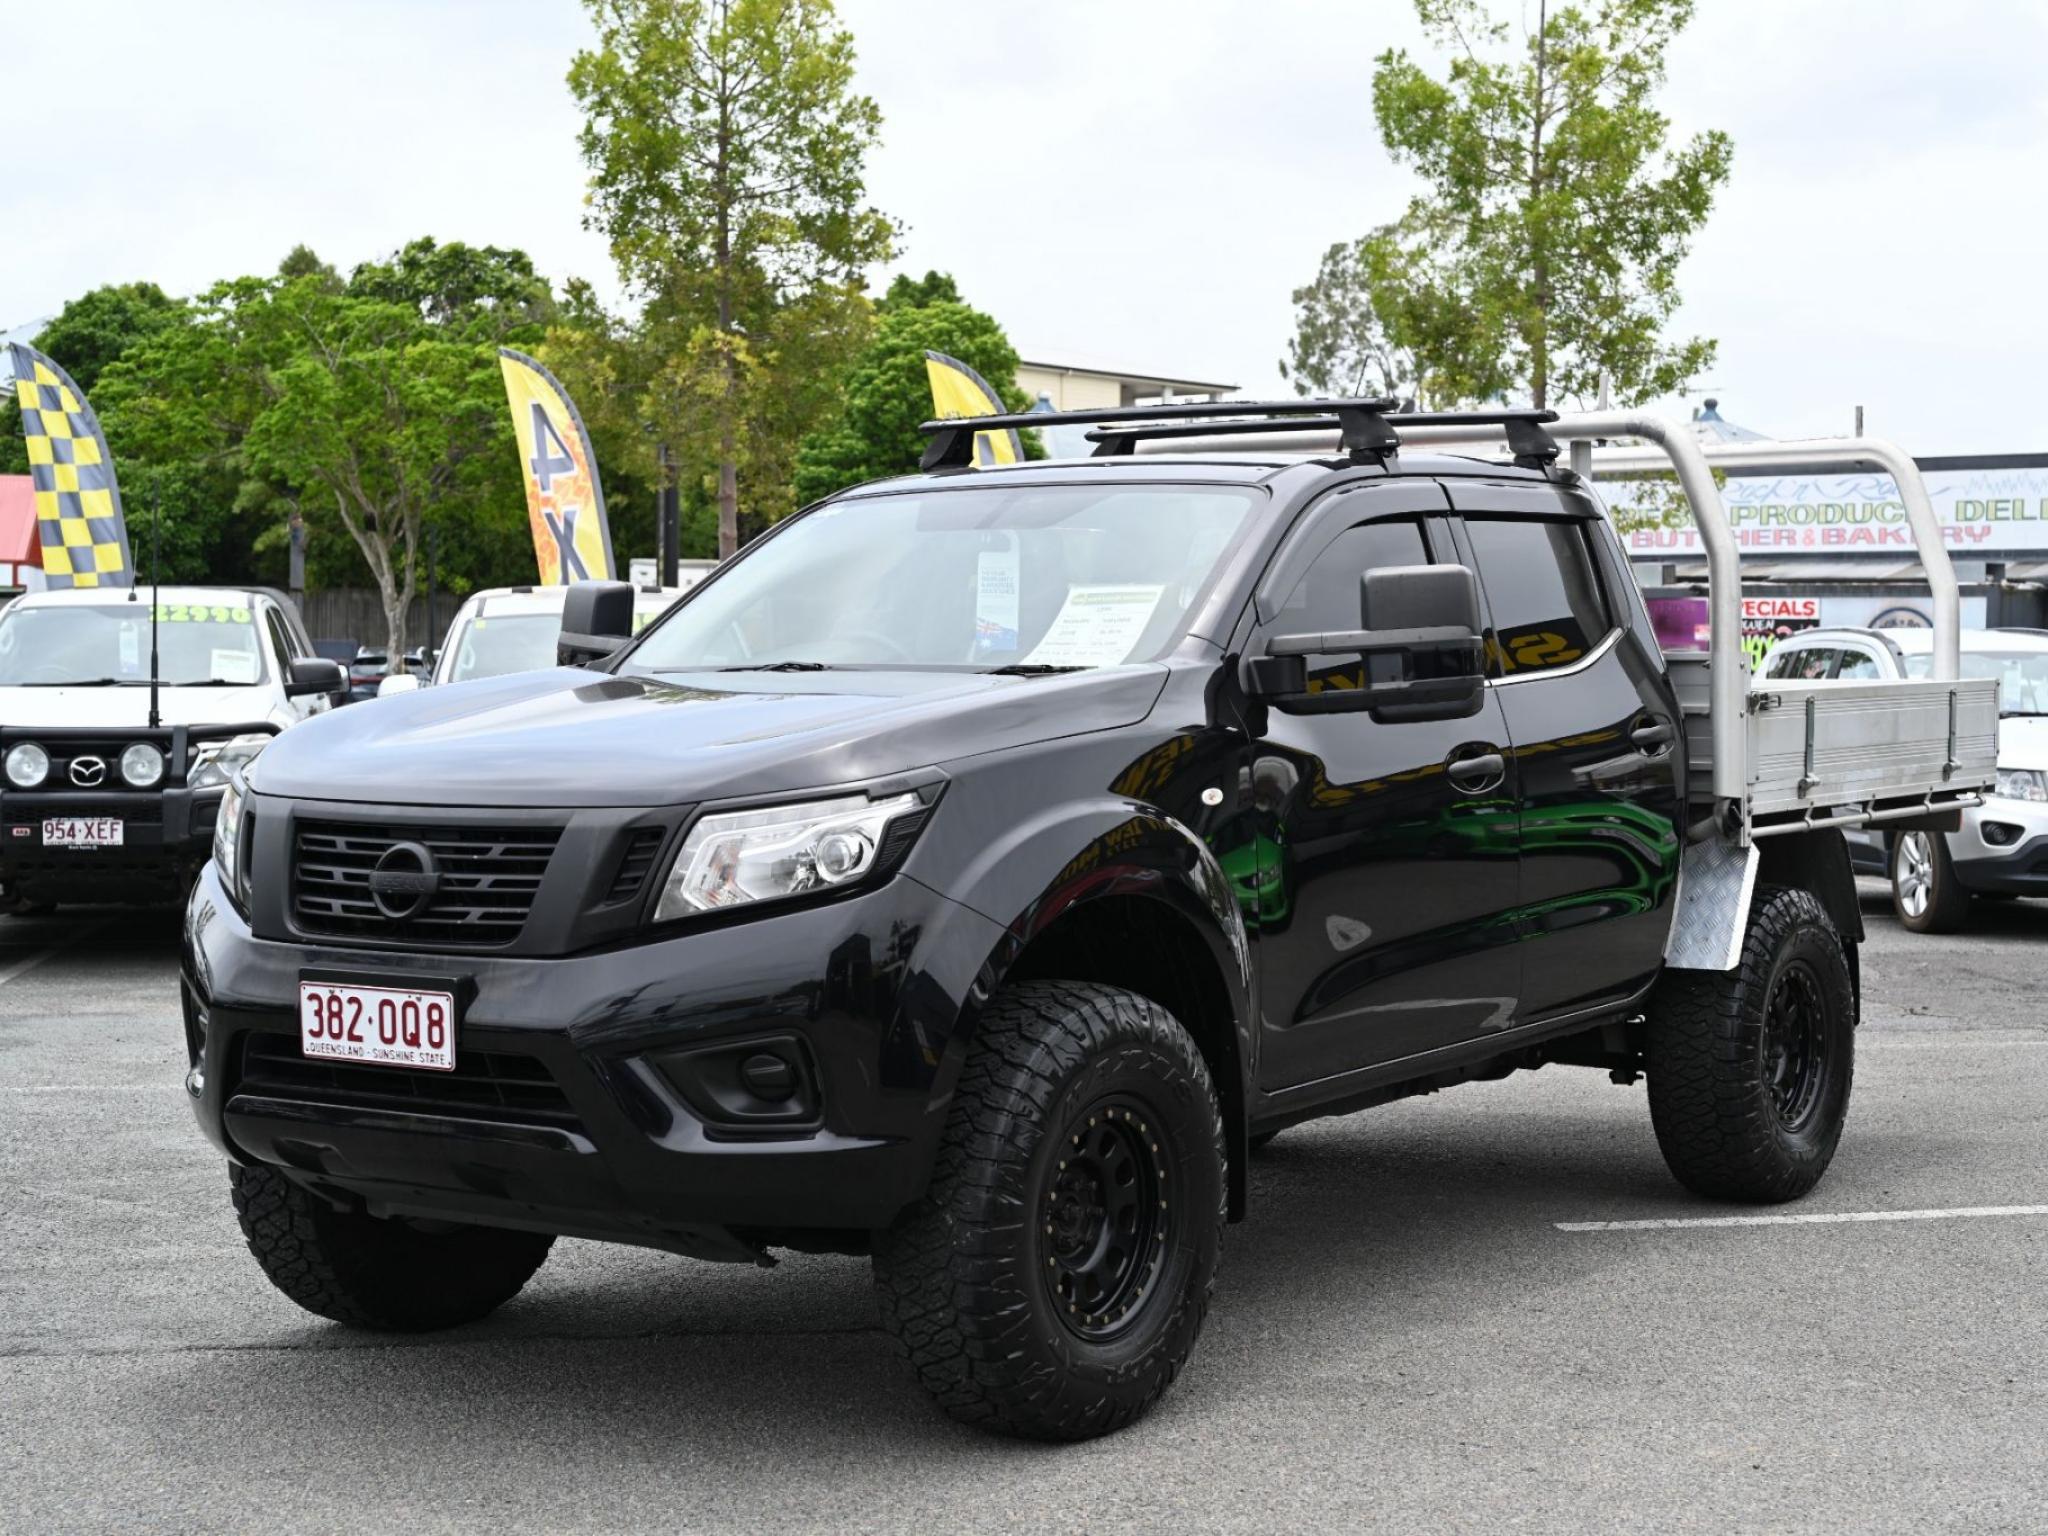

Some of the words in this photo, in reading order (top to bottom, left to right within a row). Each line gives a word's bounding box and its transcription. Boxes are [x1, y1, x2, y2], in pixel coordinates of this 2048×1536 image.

[1730, 501, 1909, 526] PRODUC
[1632, 527, 1797, 547] BUTHER
[1802, 528, 1815, 545] &
[1821, 525, 1992, 545] BAKRY
[1741, 600, 1816, 617] ECIALS
[309, 1042, 364, 1056] QUEENSLAND
[373, 1048, 415, 1062] SUNSHINE
[420, 1053, 445, 1065] STATE
